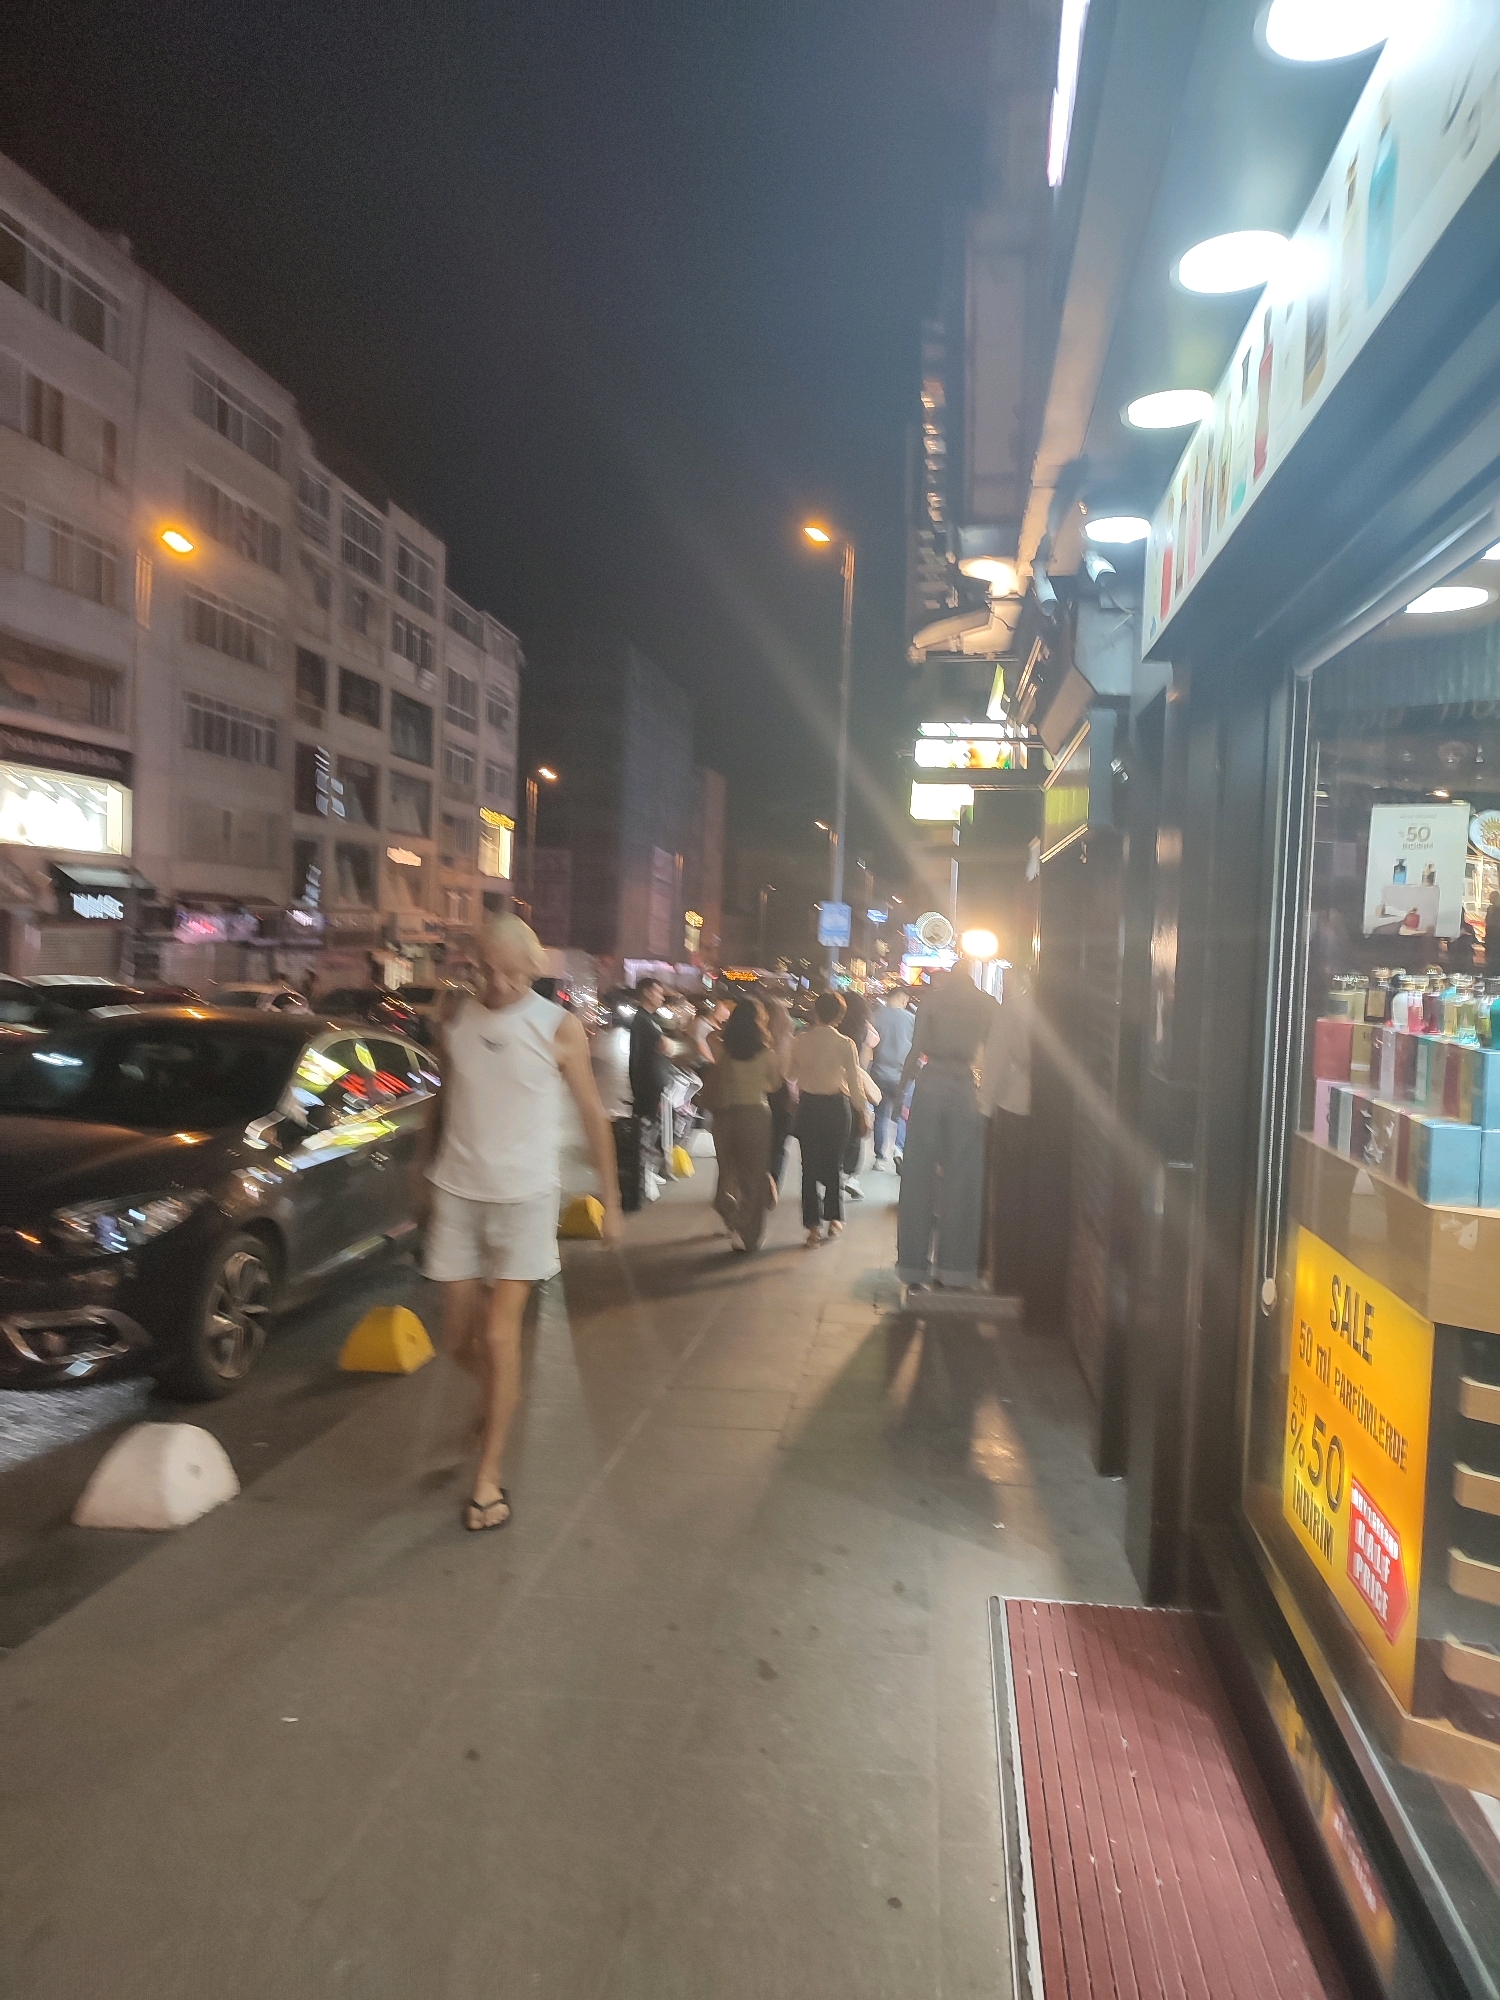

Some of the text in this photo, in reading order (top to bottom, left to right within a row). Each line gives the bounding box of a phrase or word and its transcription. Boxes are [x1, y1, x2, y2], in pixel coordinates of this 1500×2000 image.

[1330, 1274, 1375, 1366] SALE
[1299, 1319, 1409, 1474] 50 ml PARFÜMLERDE
[1293, 1468, 1335, 1566] İNDİRİM
[1355, 1518, 1391, 1584] HALF
[1354, 1552, 1389, 1622] PRICE
